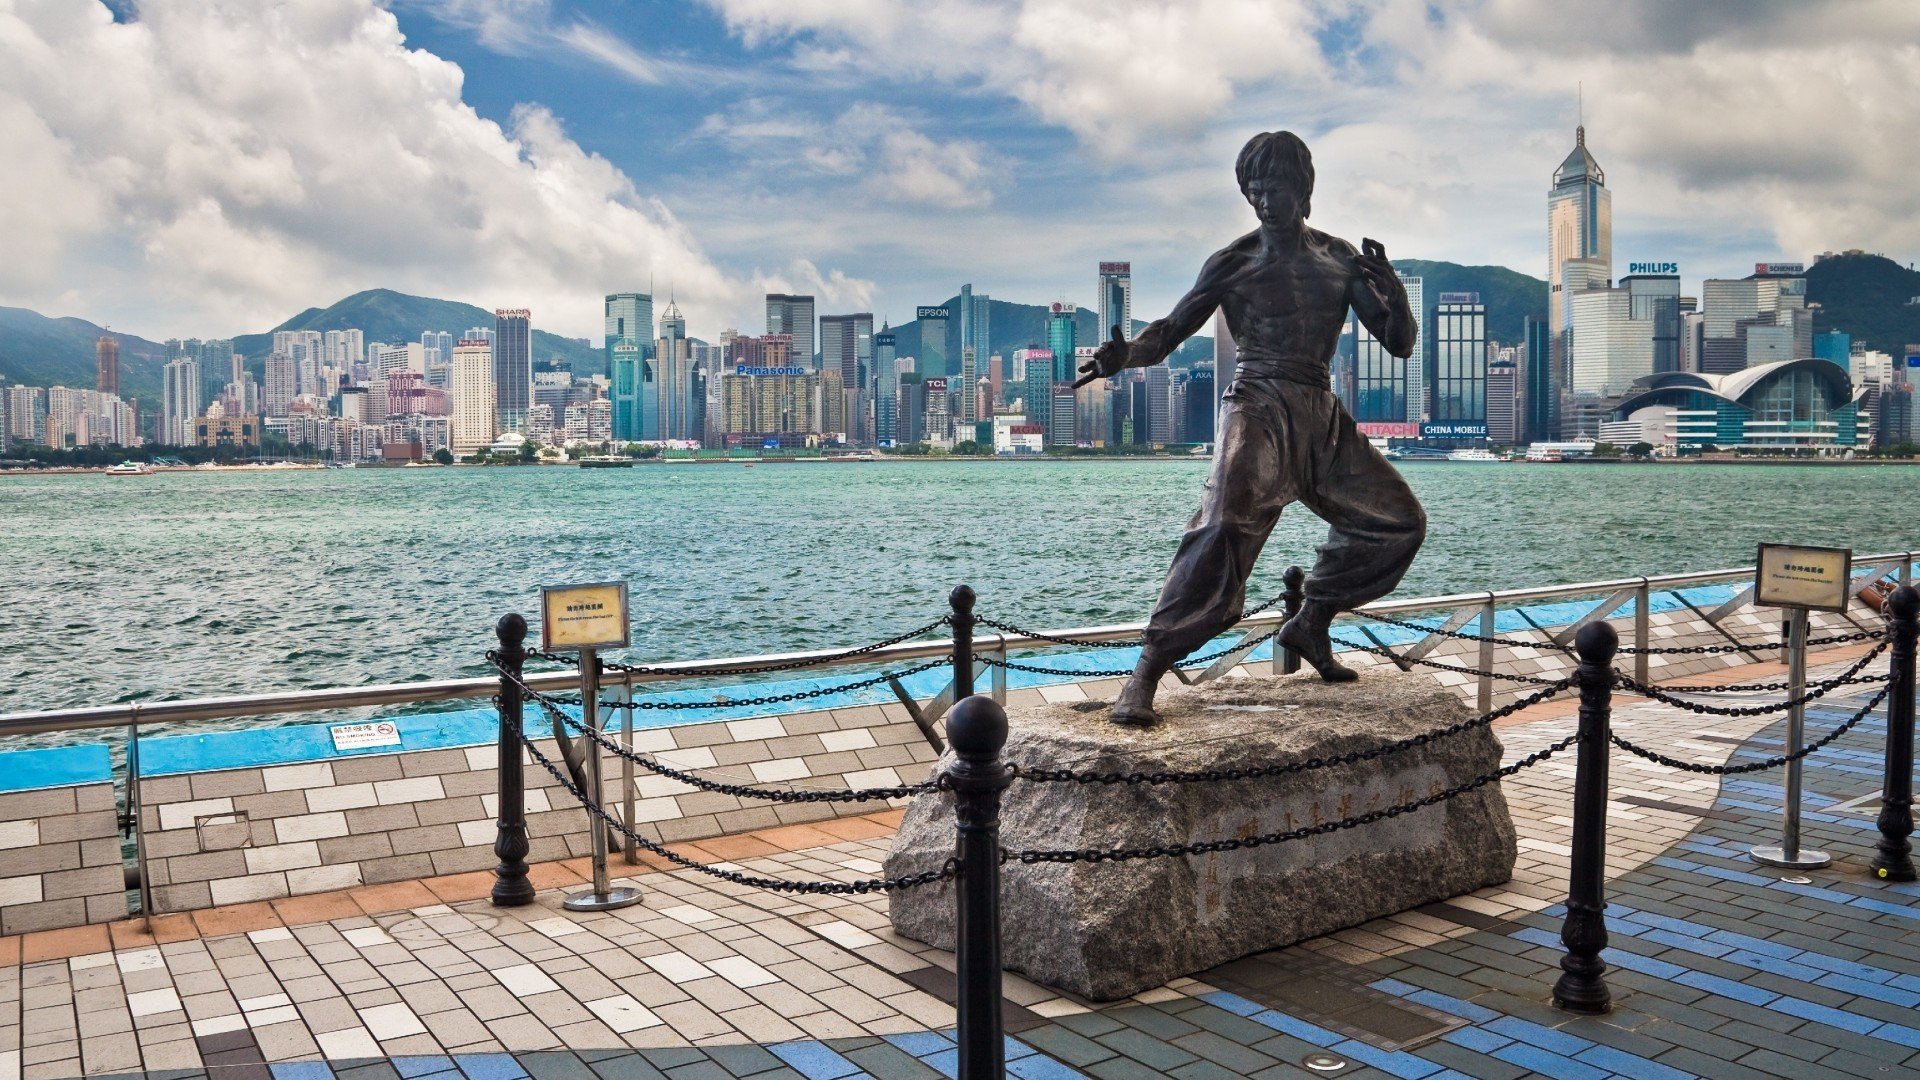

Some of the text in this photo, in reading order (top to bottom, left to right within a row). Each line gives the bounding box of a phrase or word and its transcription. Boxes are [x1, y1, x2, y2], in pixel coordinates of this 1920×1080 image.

[1630, 262, 1678, 273] PHILIPS
[495, 308, 530, 316] SHARP
[918, 308, 949, 317] EPSON
[737, 365, 804, 375] Panasonic
[927, 380, 947, 388] TCL
[1010, 425, 1042, 434] MGM
[1358, 424, 1417, 435] HITACHI
[1424, 426, 1486, 434] CHINA MOBILE
